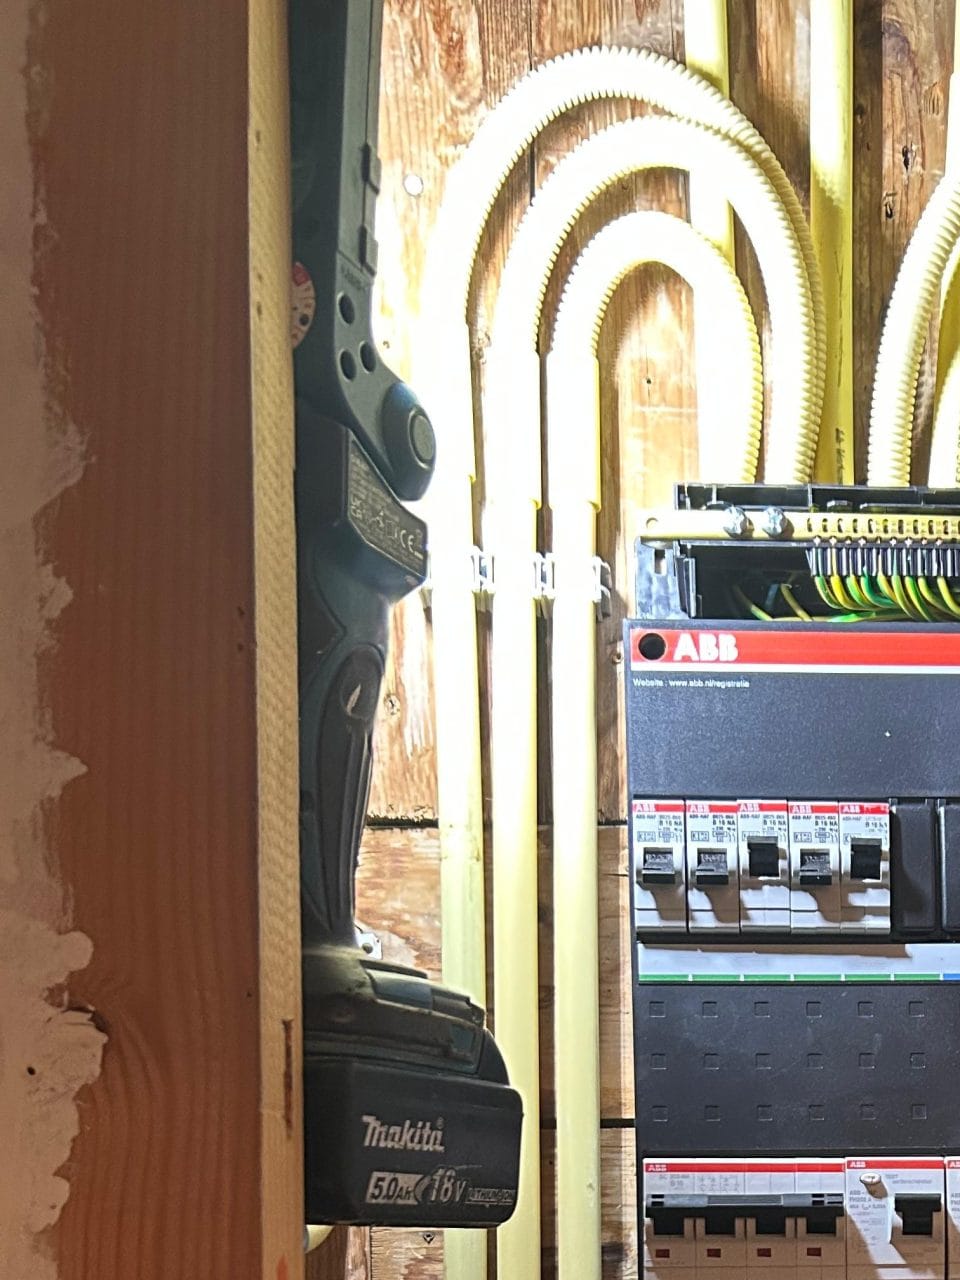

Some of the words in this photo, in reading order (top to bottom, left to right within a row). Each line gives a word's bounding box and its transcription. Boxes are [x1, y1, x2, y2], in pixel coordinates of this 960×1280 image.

[673, 633, 739, 662] ABB
[633, 678, 664, 687] Website
[361, 1114, 445, 1152] Makita
[648, 1164, 667, 1172] ABB
